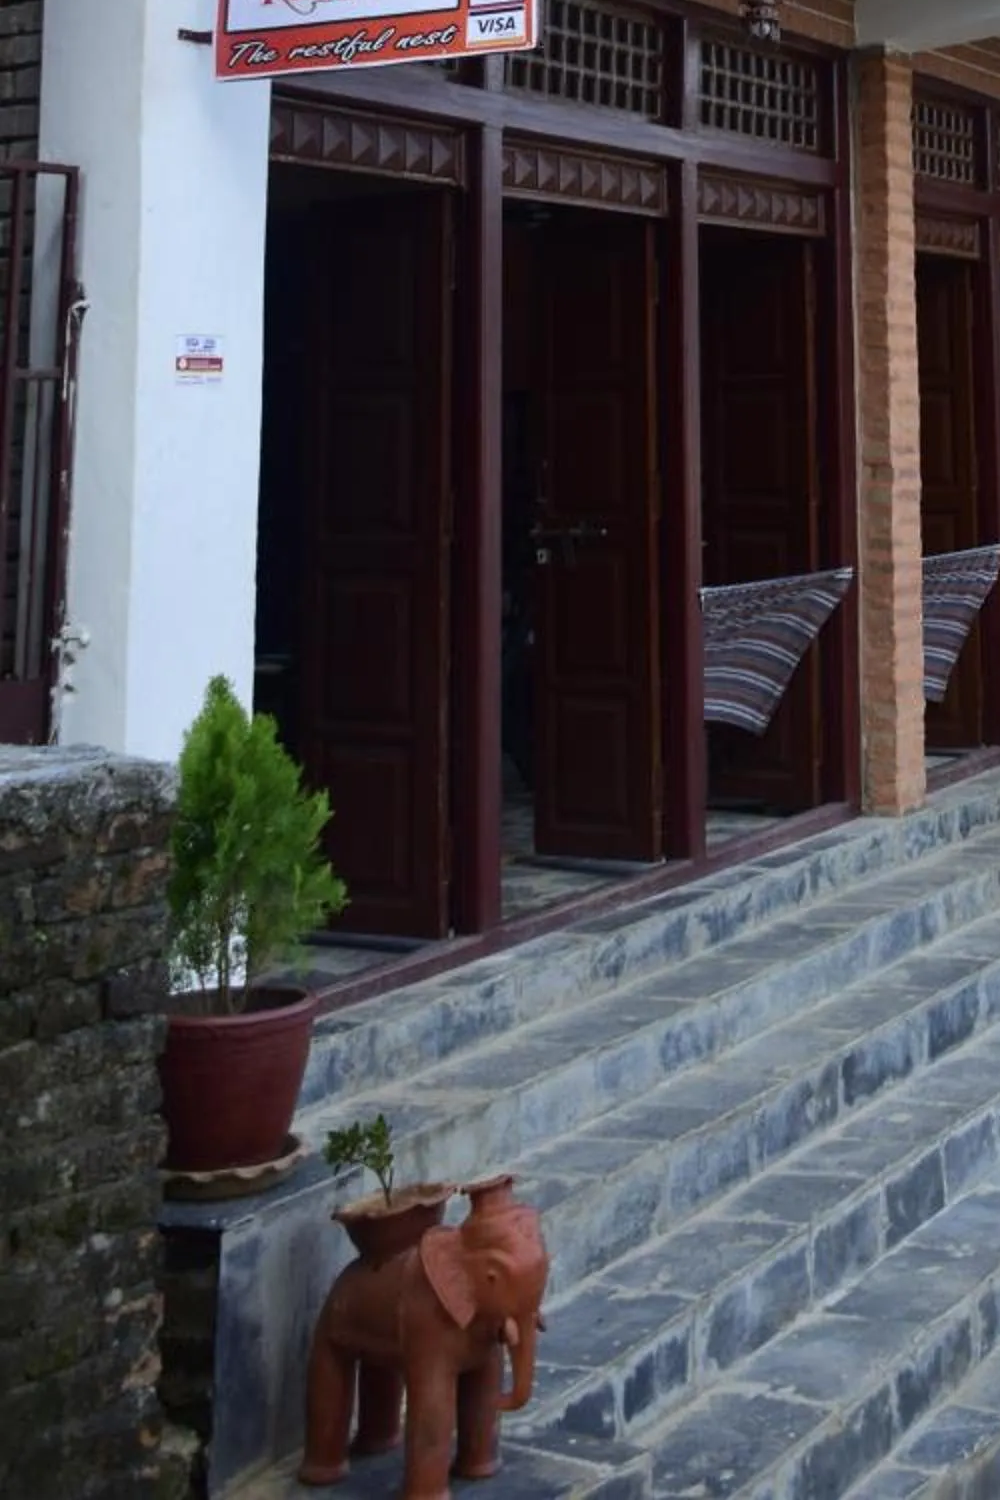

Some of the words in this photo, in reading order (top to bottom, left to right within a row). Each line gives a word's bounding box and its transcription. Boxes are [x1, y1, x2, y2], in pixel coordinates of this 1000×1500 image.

[478, 16, 516, 34] VISA
[229, 40, 279, 68] The
[288, 27, 396, 62] restful
[396, 23, 459, 49] nest
